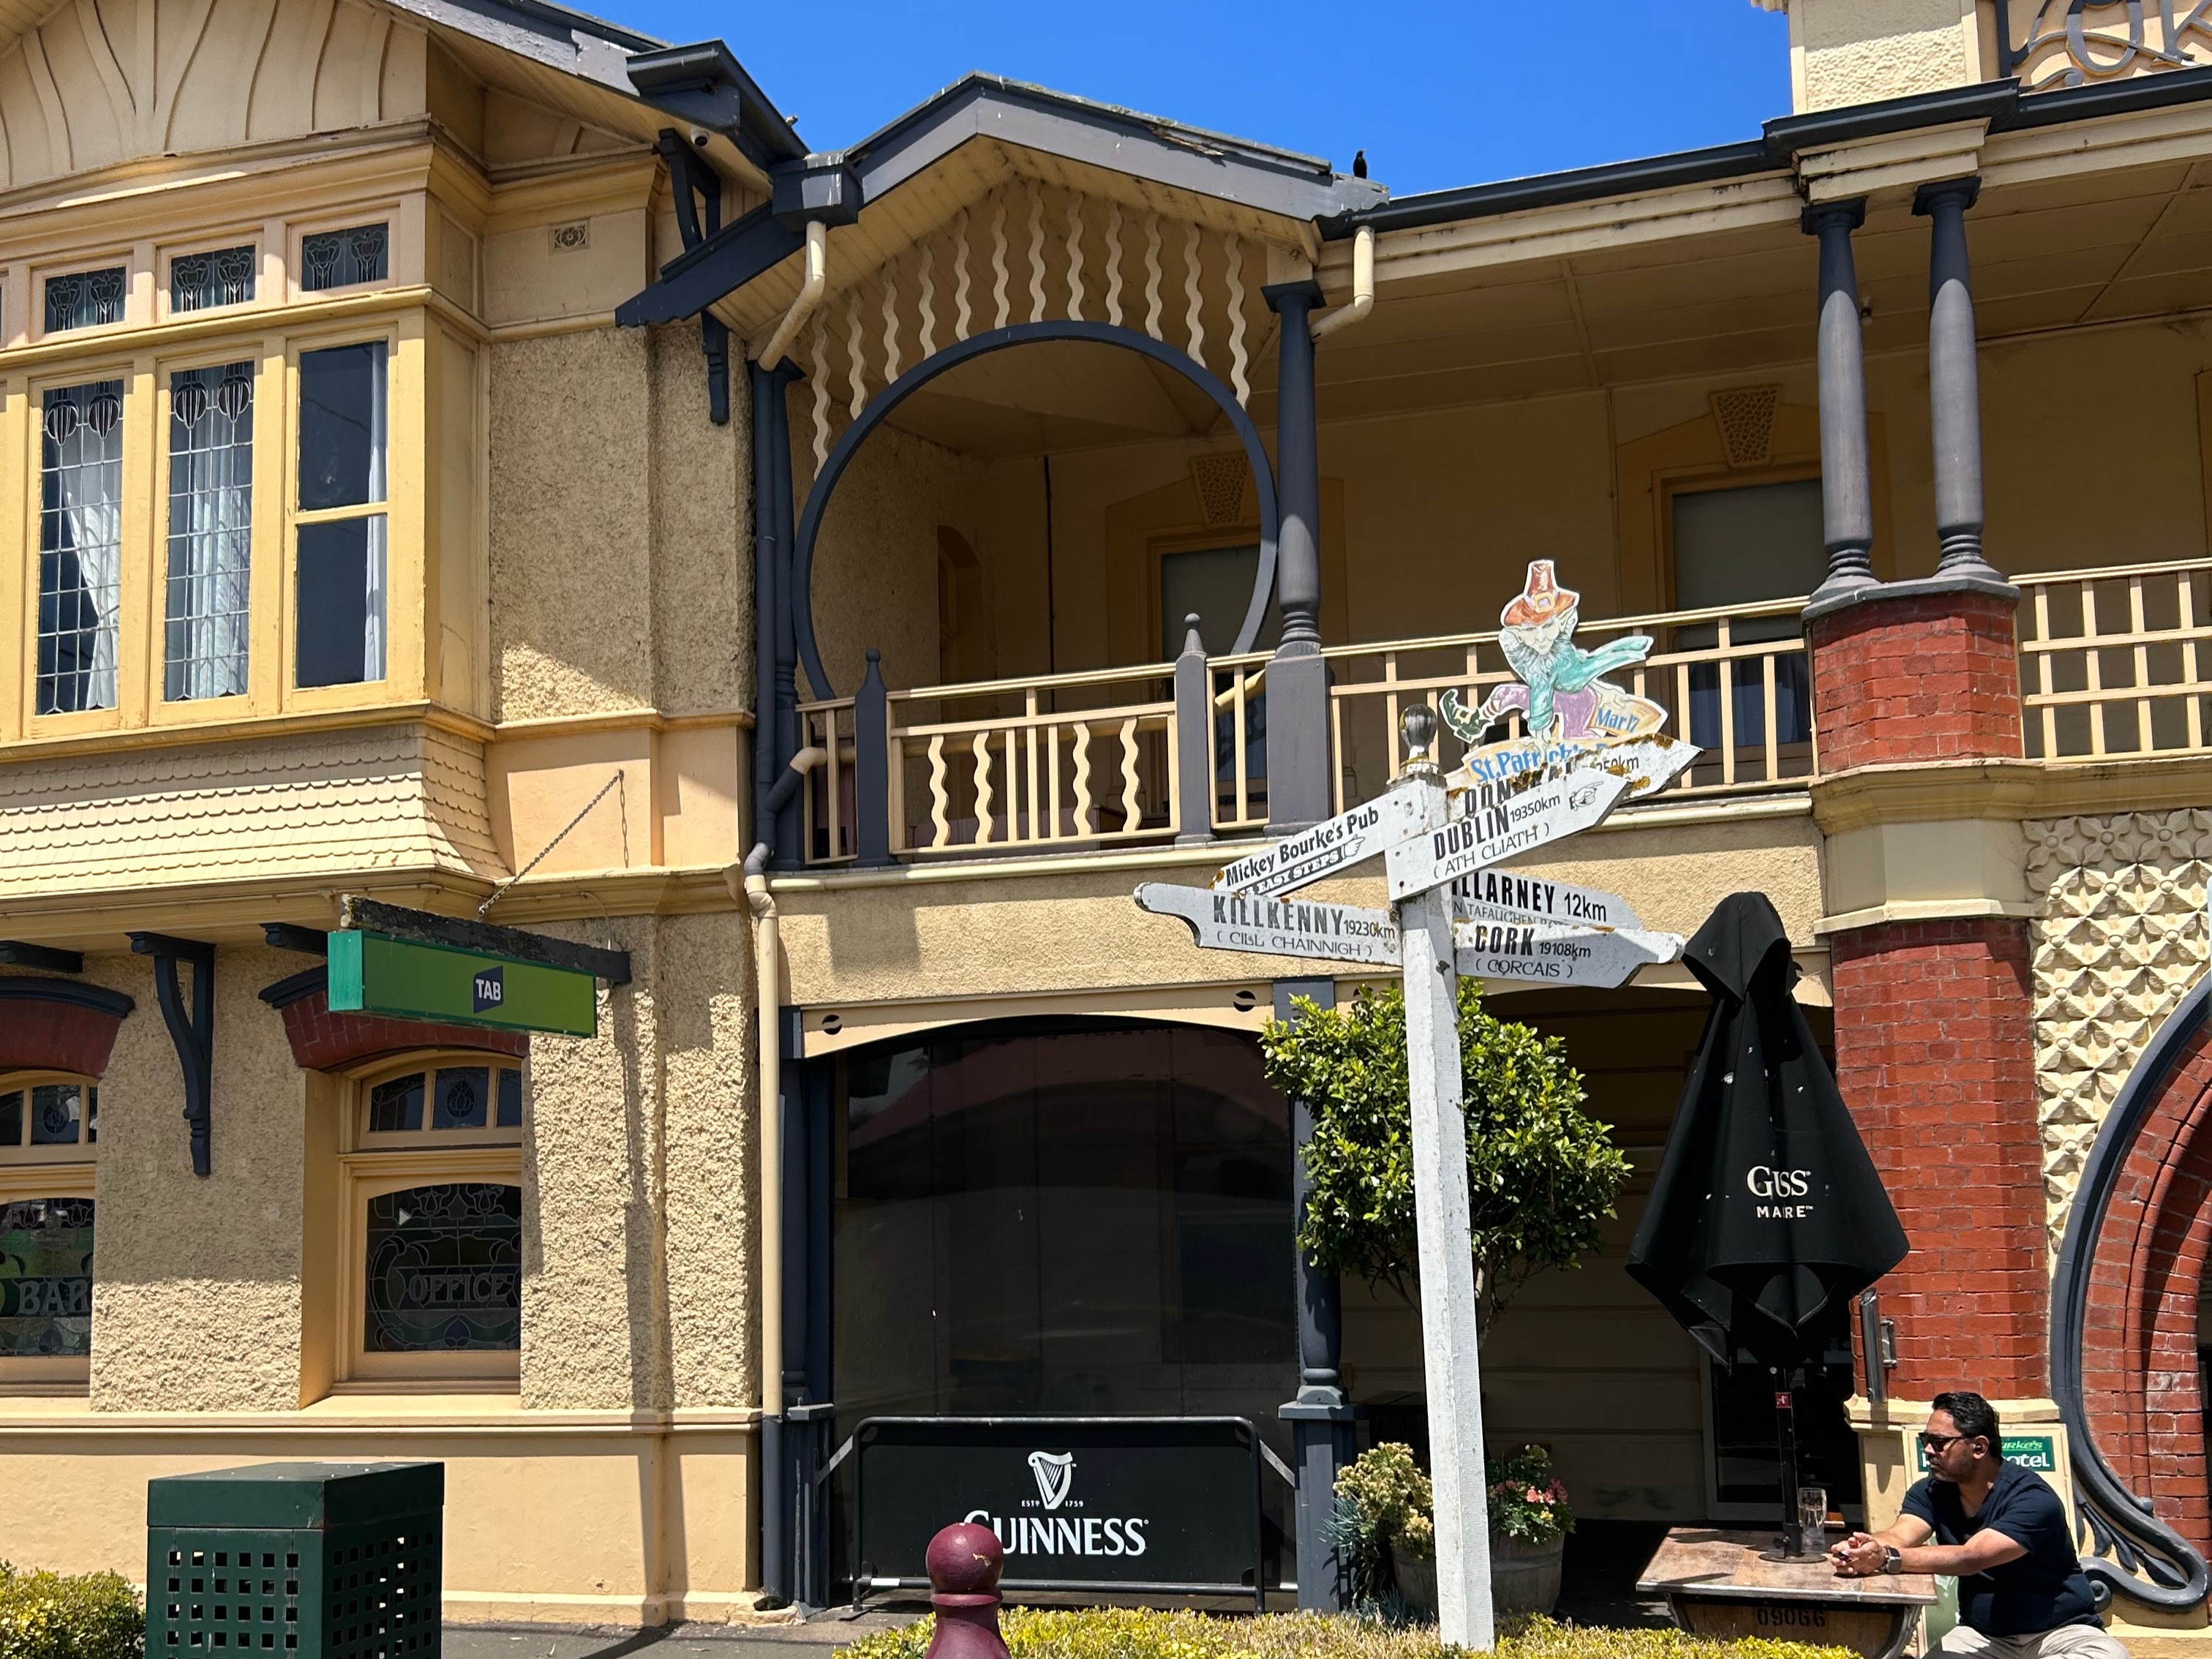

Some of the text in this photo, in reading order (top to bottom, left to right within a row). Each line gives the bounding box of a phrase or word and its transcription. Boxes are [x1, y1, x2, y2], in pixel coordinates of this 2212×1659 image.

[1595, 707, 1640, 733] Mar 17
[1226, 806, 1379, 887] Mickey Bourke's Pub
[1433, 795, 1560, 861] DUBLIN 19350km
[1257, 869, 1291, 893] EASY
[1293, 850, 1339, 879] STEPS
[1214, 895, 1395, 939] KILLKENNY 19230km
[1452, 872, 1606, 922] ILLARNEY 12km
[1475, 925, 1592, 958] CORK 19108km
[475, 979, 501, 1001] TAB
[15, 1280, 91, 1317] BAR
[408, 1274, 514, 1302] OFFICE
